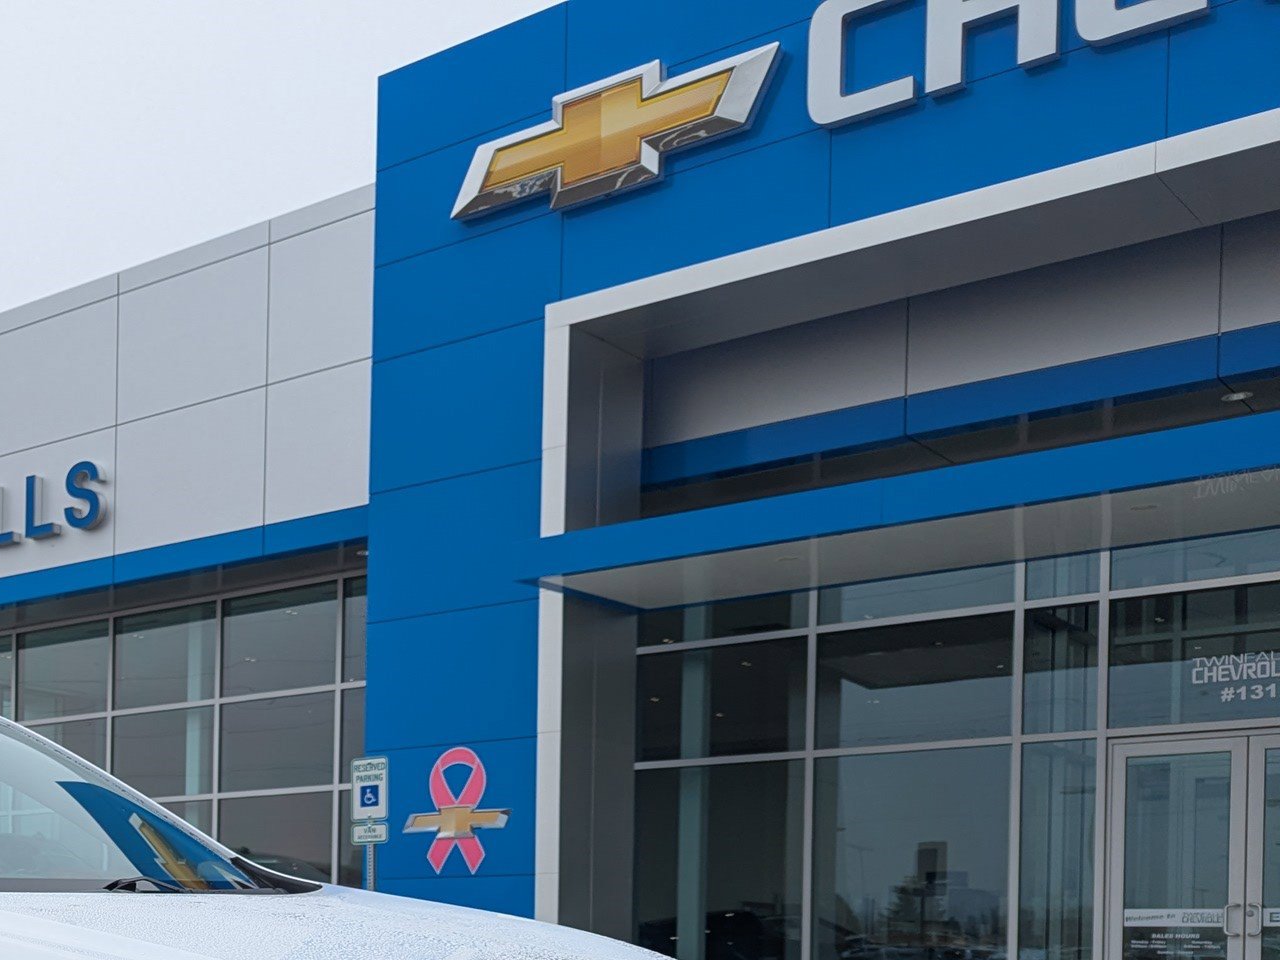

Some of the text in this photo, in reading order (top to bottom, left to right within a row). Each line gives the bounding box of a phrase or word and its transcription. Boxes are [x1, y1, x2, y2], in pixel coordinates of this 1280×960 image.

[808, 0, 1212, 128] CH
[353, 762, 386, 773] RESERVED
[355, 773, 384, 784] PARKING
